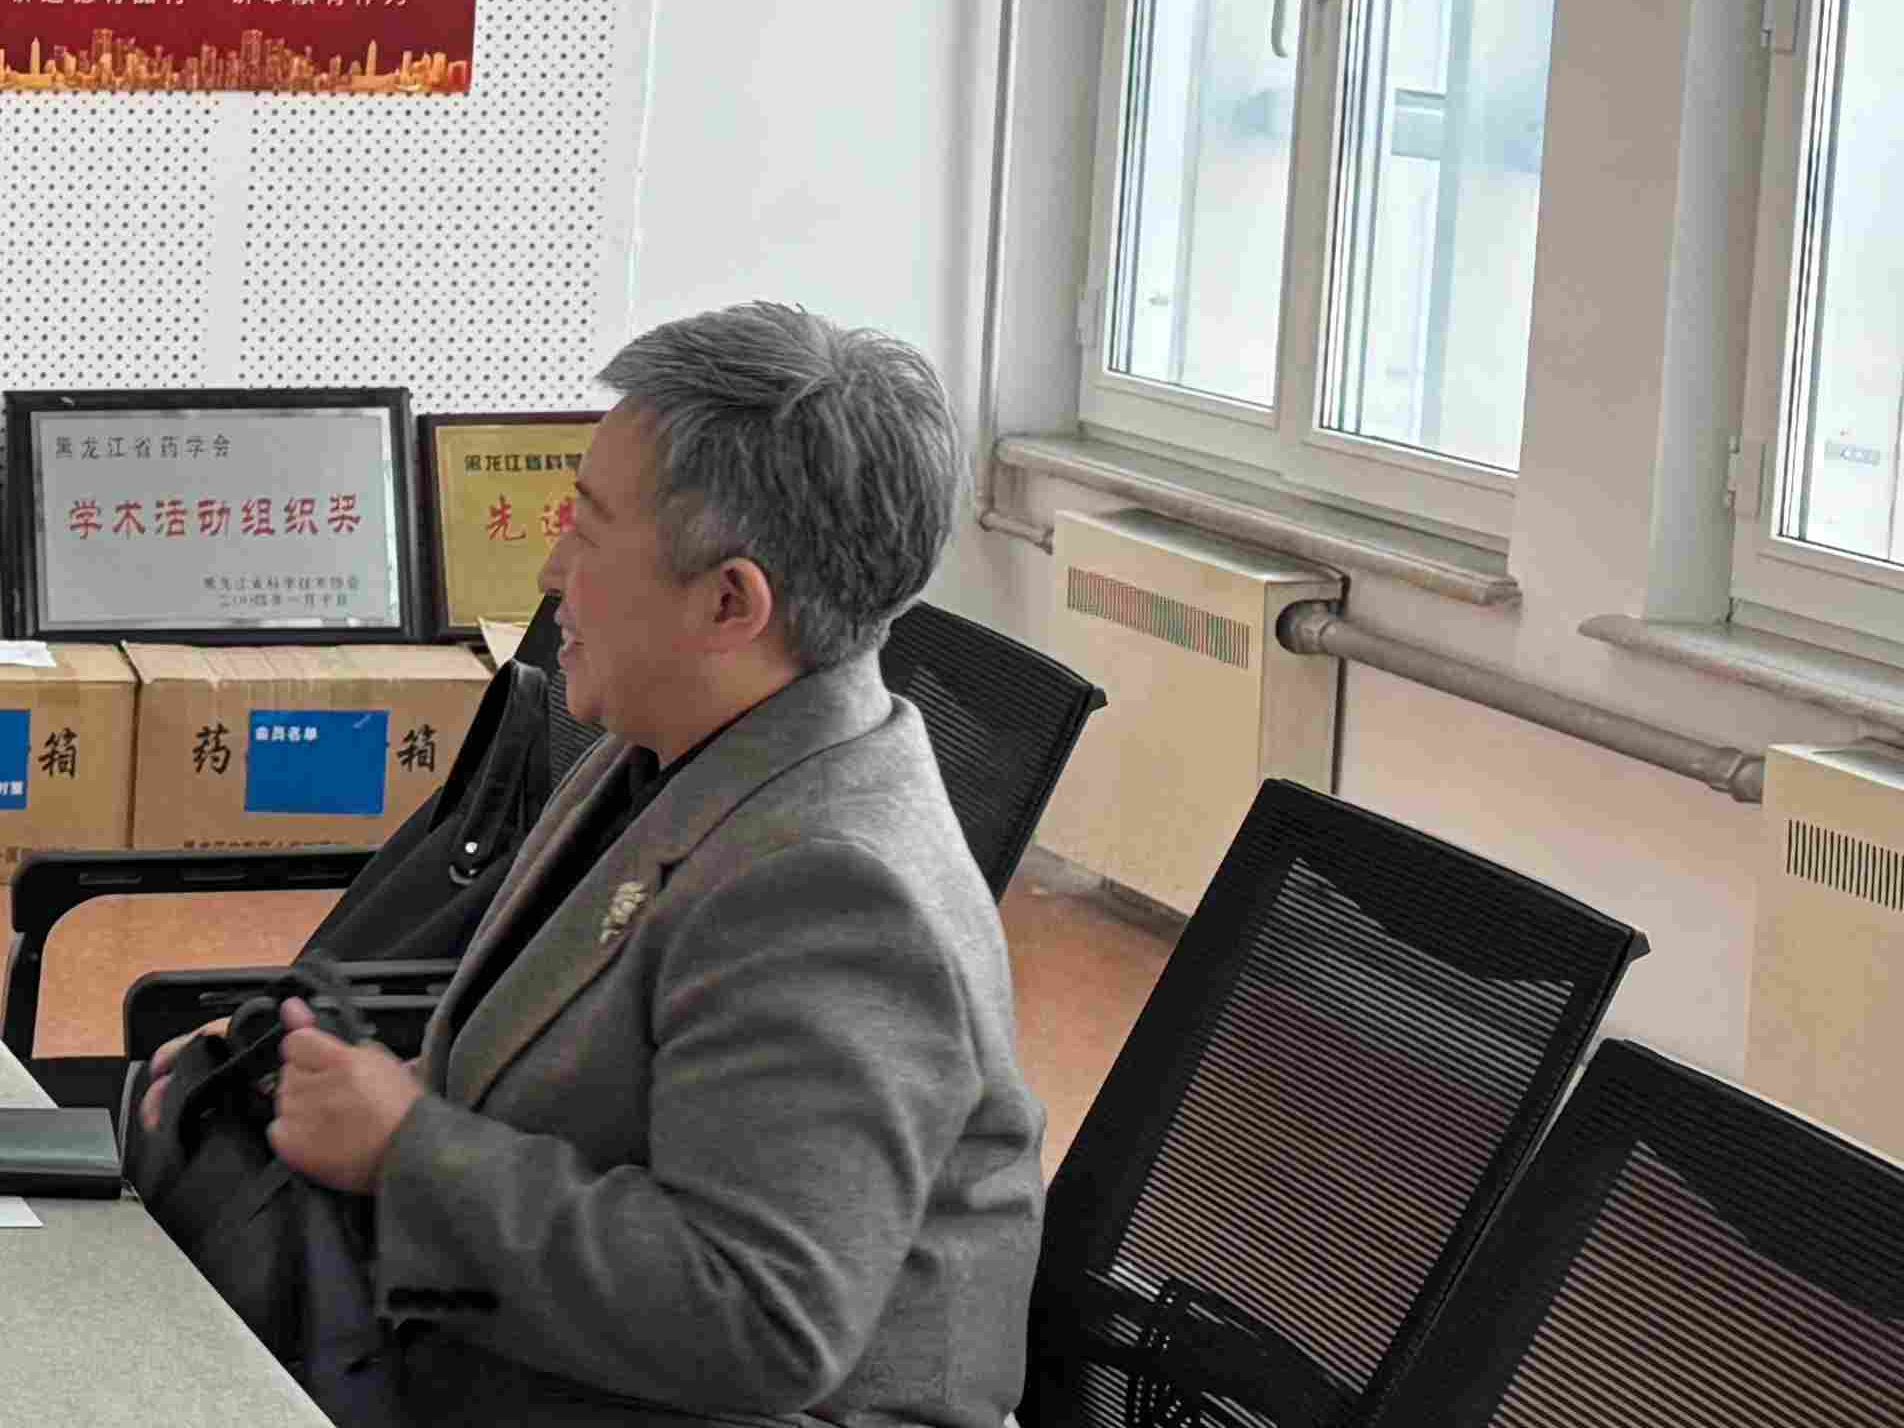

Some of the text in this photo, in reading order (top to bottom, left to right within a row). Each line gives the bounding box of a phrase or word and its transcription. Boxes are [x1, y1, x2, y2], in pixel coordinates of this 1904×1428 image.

[55, 435, 231, 460] 黑龙江省药学会
[67, 492, 362, 540] 学术活动组织奖
[37, 729, 79, 779] 箱
[191, 722, 441, 777] 药 箱
